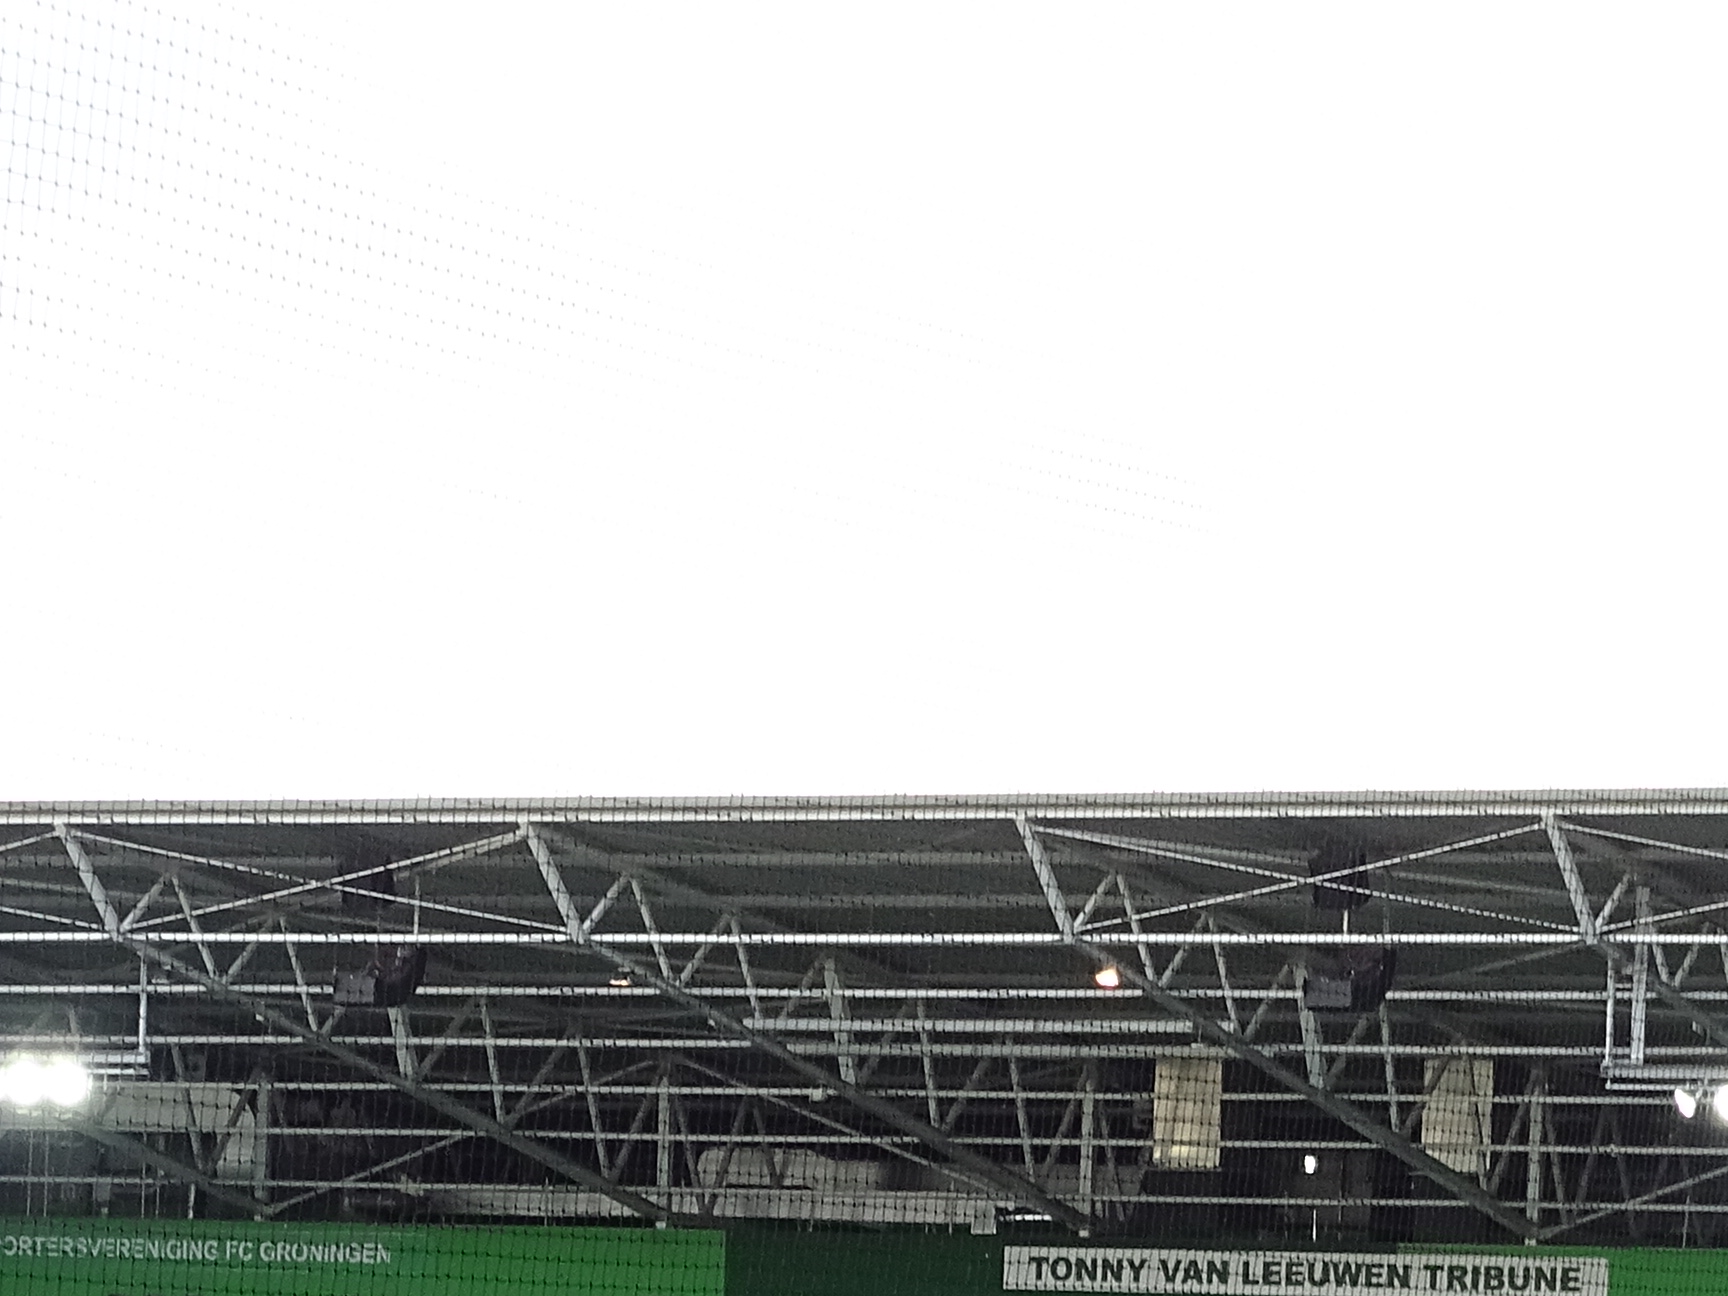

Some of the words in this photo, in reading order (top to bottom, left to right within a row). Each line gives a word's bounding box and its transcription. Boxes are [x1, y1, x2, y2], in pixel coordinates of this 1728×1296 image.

[224, 1239, 254, 1262] FC
[260, 1242, 392, 1264] GRONINGEN
[1029, 1256, 1149, 1285] TONNY
[1159, 1257, 1229, 1286] VAN
[1241, 1258, 1412, 1291] LEEUWEN
[1424, 1264, 1582, 1293] TRIBUNE
